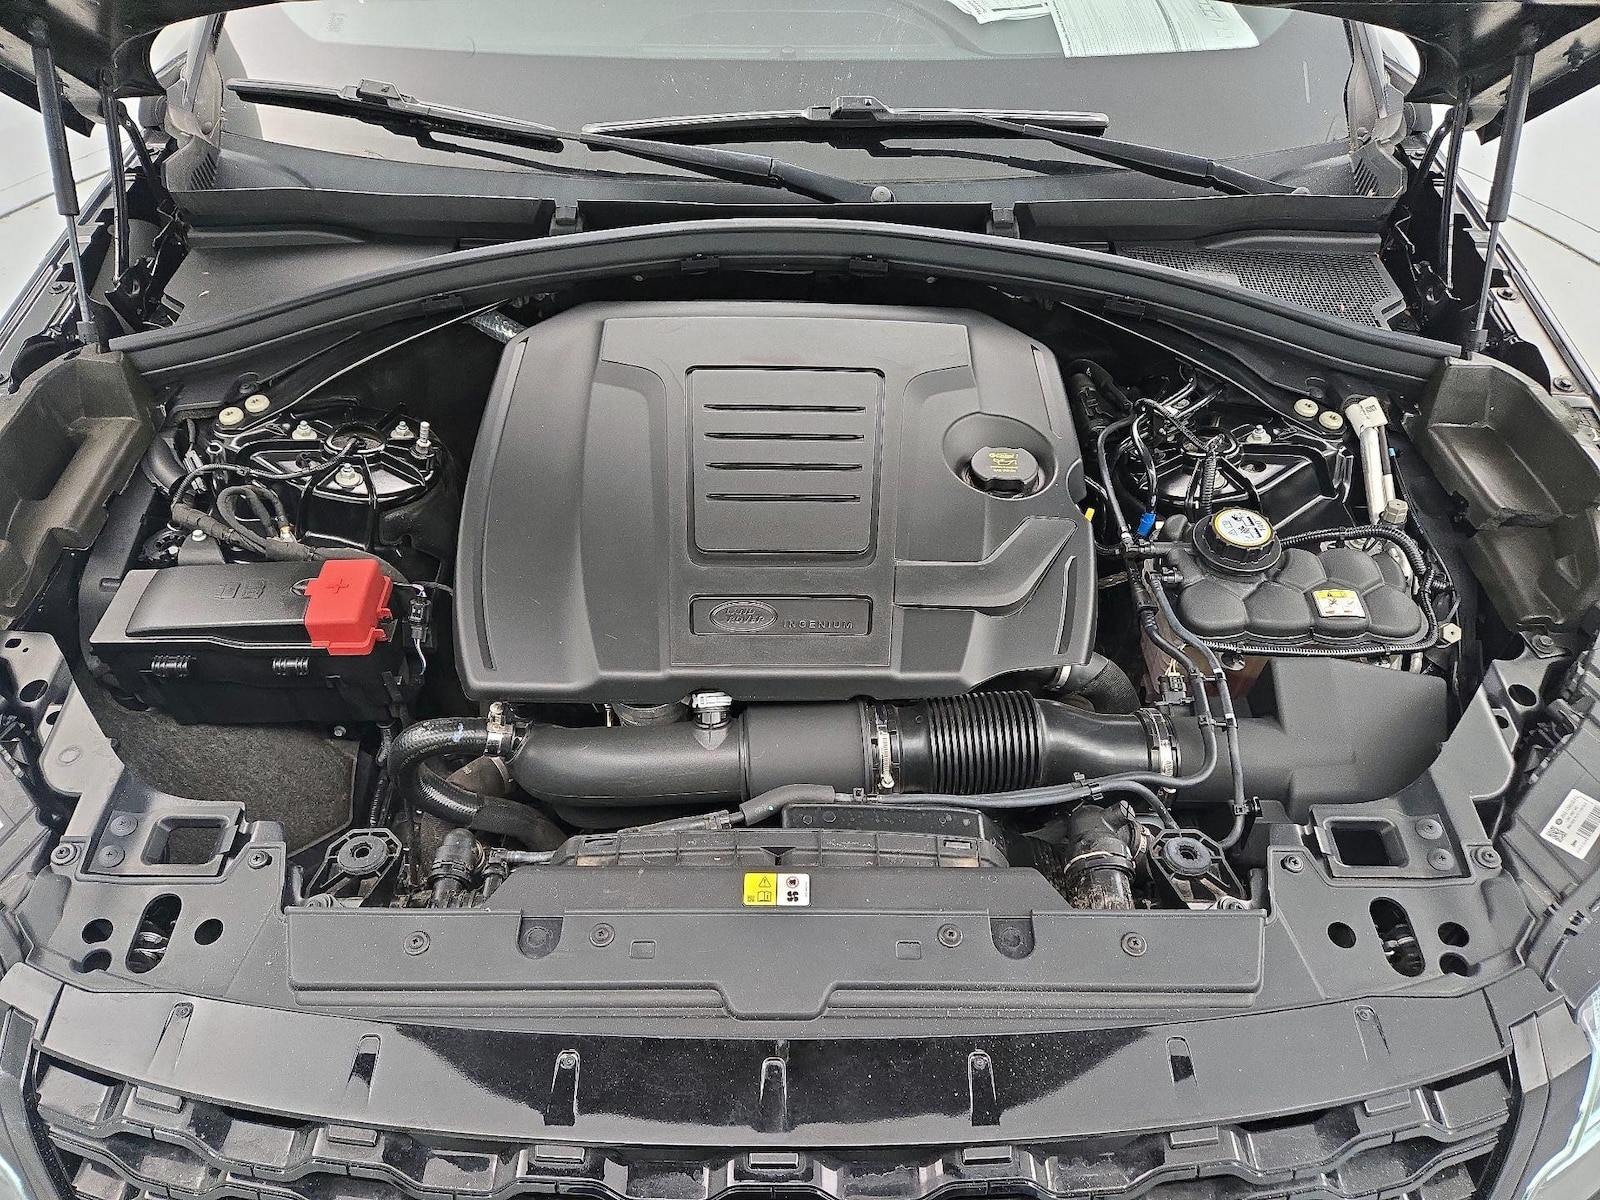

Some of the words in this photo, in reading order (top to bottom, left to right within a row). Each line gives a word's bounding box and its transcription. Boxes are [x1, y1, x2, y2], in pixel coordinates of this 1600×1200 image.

[724, 607, 757, 616] LAND
[726, 615, 765, 624] ROVER
[783, 619, 854, 629] INGENIUM
